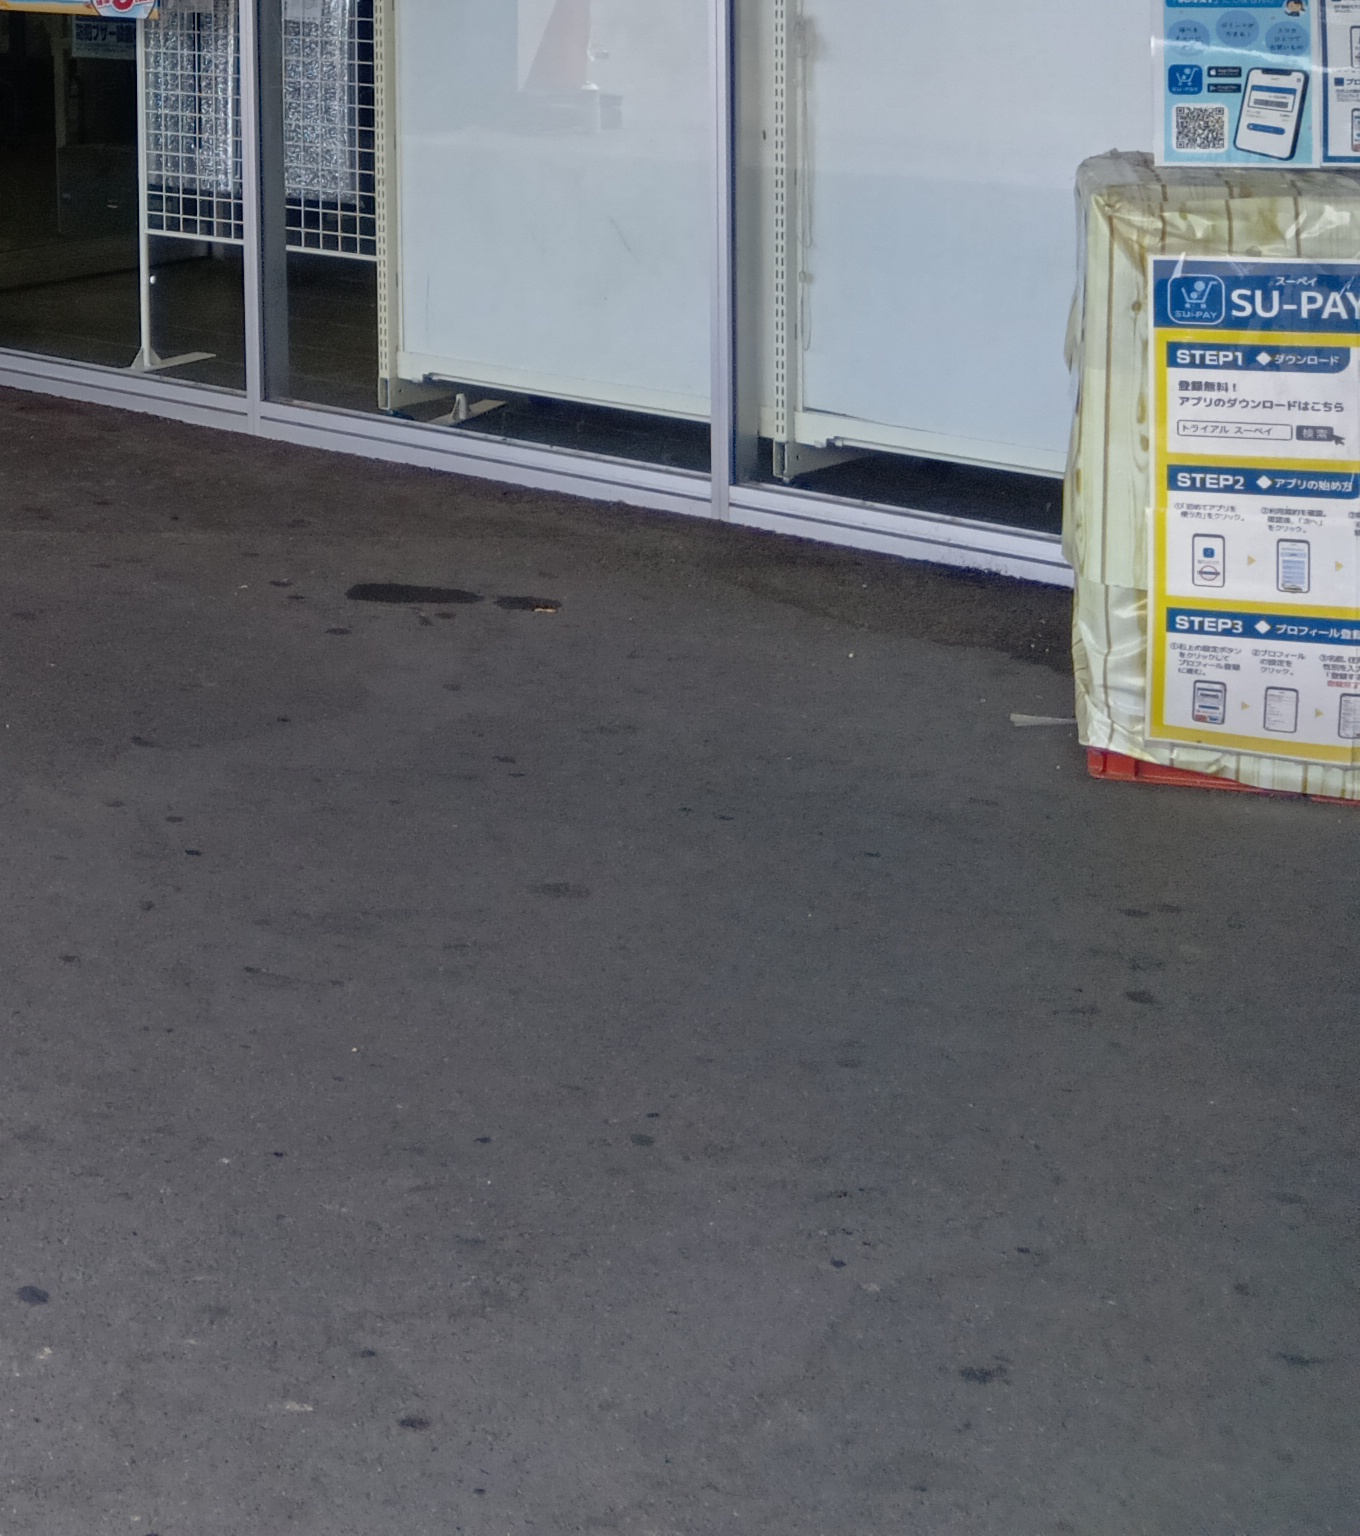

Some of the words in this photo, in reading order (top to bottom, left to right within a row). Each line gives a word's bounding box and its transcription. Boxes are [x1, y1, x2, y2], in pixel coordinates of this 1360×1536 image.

[1275, 276, 1318, 287] スーペイ
[1174, 310, 1217, 319] SU-PAY
[1176, 349, 1243, 366] STEP1
[1274, 353, 1341, 366] ダウンロード
[1178, 396, 1345, 413] アプリのダウンロードはこちら
[1182, 424, 1230, 435] トライアル
[1235, 426, 1273, 437] スーペイ
[1177, 472, 1245, 490] STEP2
[1275, 477, 1354, 493] アプリの始め方
[1175, 615, 1243, 633] STEP3
